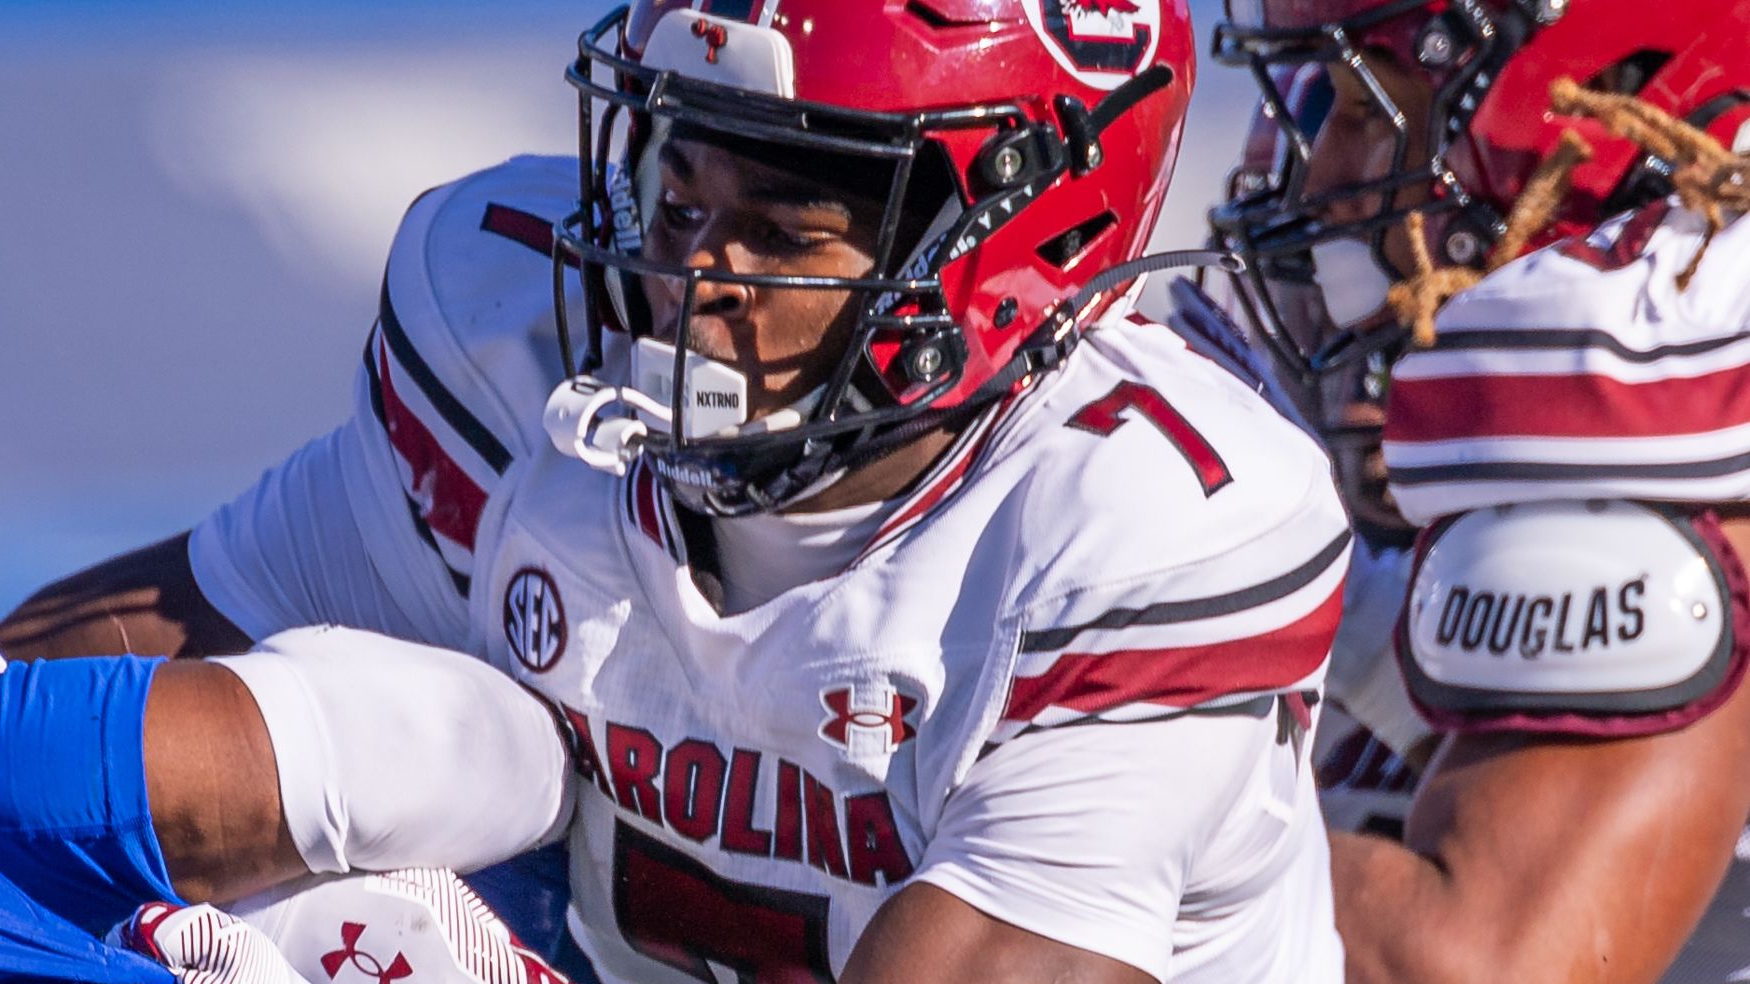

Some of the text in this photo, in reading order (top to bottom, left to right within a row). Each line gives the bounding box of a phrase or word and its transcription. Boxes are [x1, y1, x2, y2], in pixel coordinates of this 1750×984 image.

[1065, 379, 1235, 499] 7
[507, 572, 561, 668] SEC
[1436, 579, 1646, 660] DOUGLAS
[553, 700, 915, 889] AROLINA
